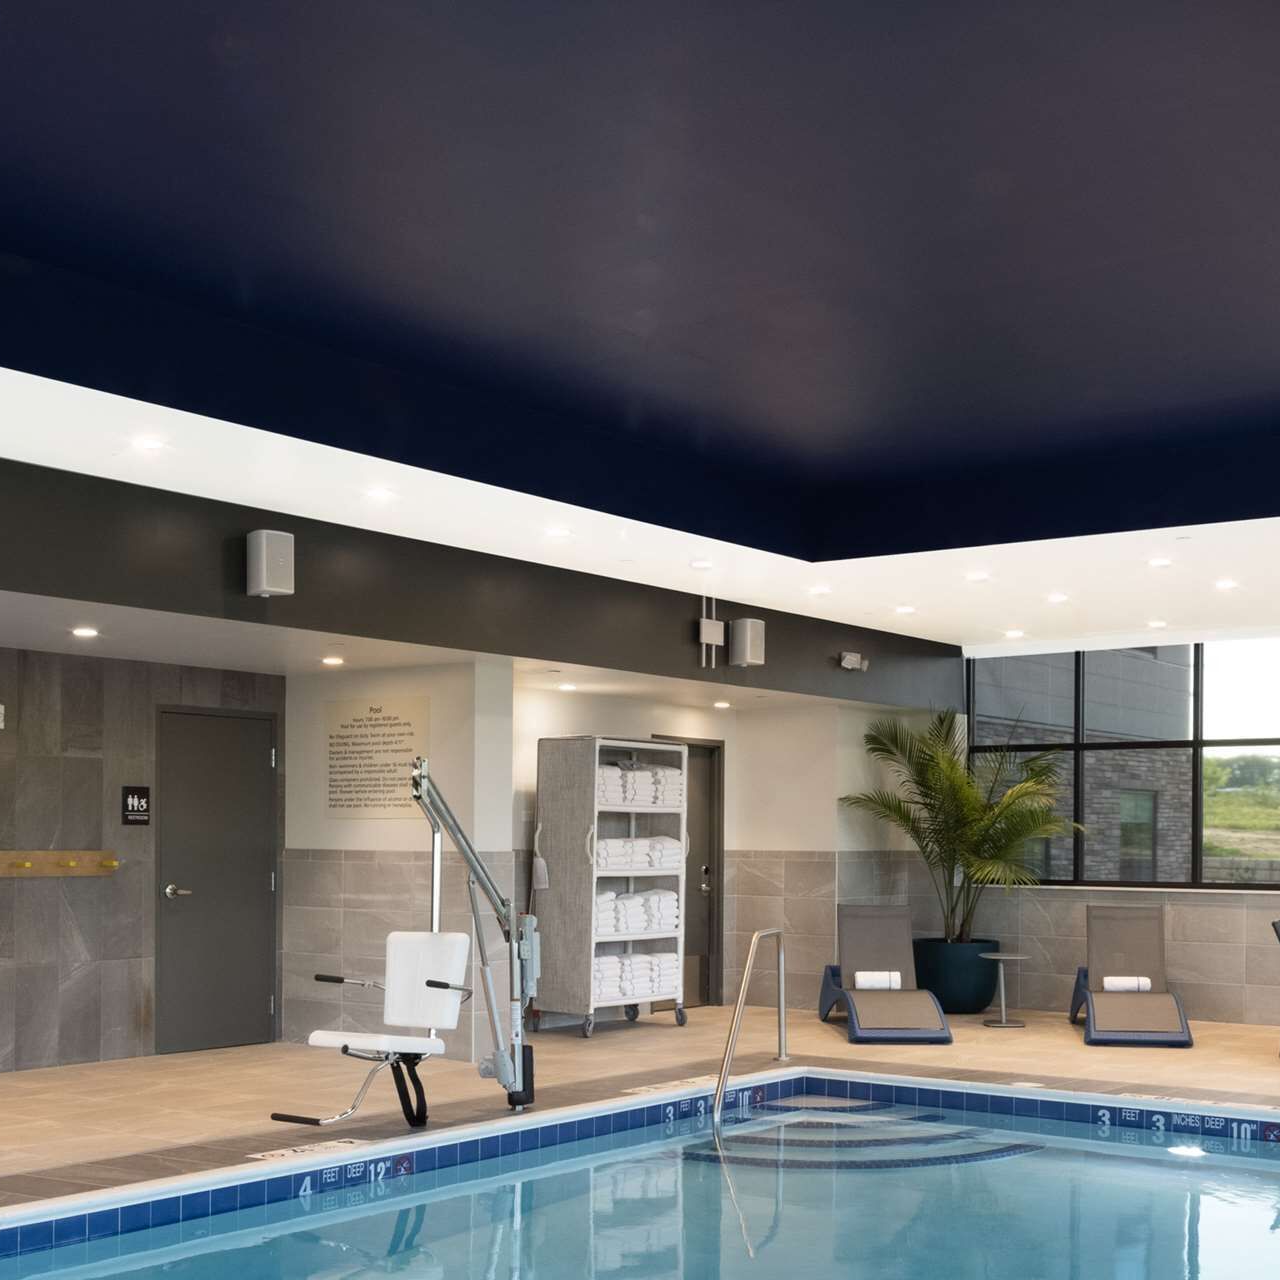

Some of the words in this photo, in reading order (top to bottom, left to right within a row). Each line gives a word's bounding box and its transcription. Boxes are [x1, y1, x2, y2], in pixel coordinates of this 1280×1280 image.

[369, 706, 383, 714] Pool
[665, 1106, 674, 1122] 3
[696, 1099, 705, 1117] 3
[1097, 1109, 1111, 1126] 3
[1121, 1108, 1140, 1121] FEET
[1152, 1114, 1165, 1131] 3
[1172, 1114, 1201, 1128] INCHES
[1204, 1116, 1225, 1129] DEEP
[299, 1175, 312, 1196] 4
[322, 1167, 339, 1184] FEET
[347, 1162, 365, 1179] DEEP
